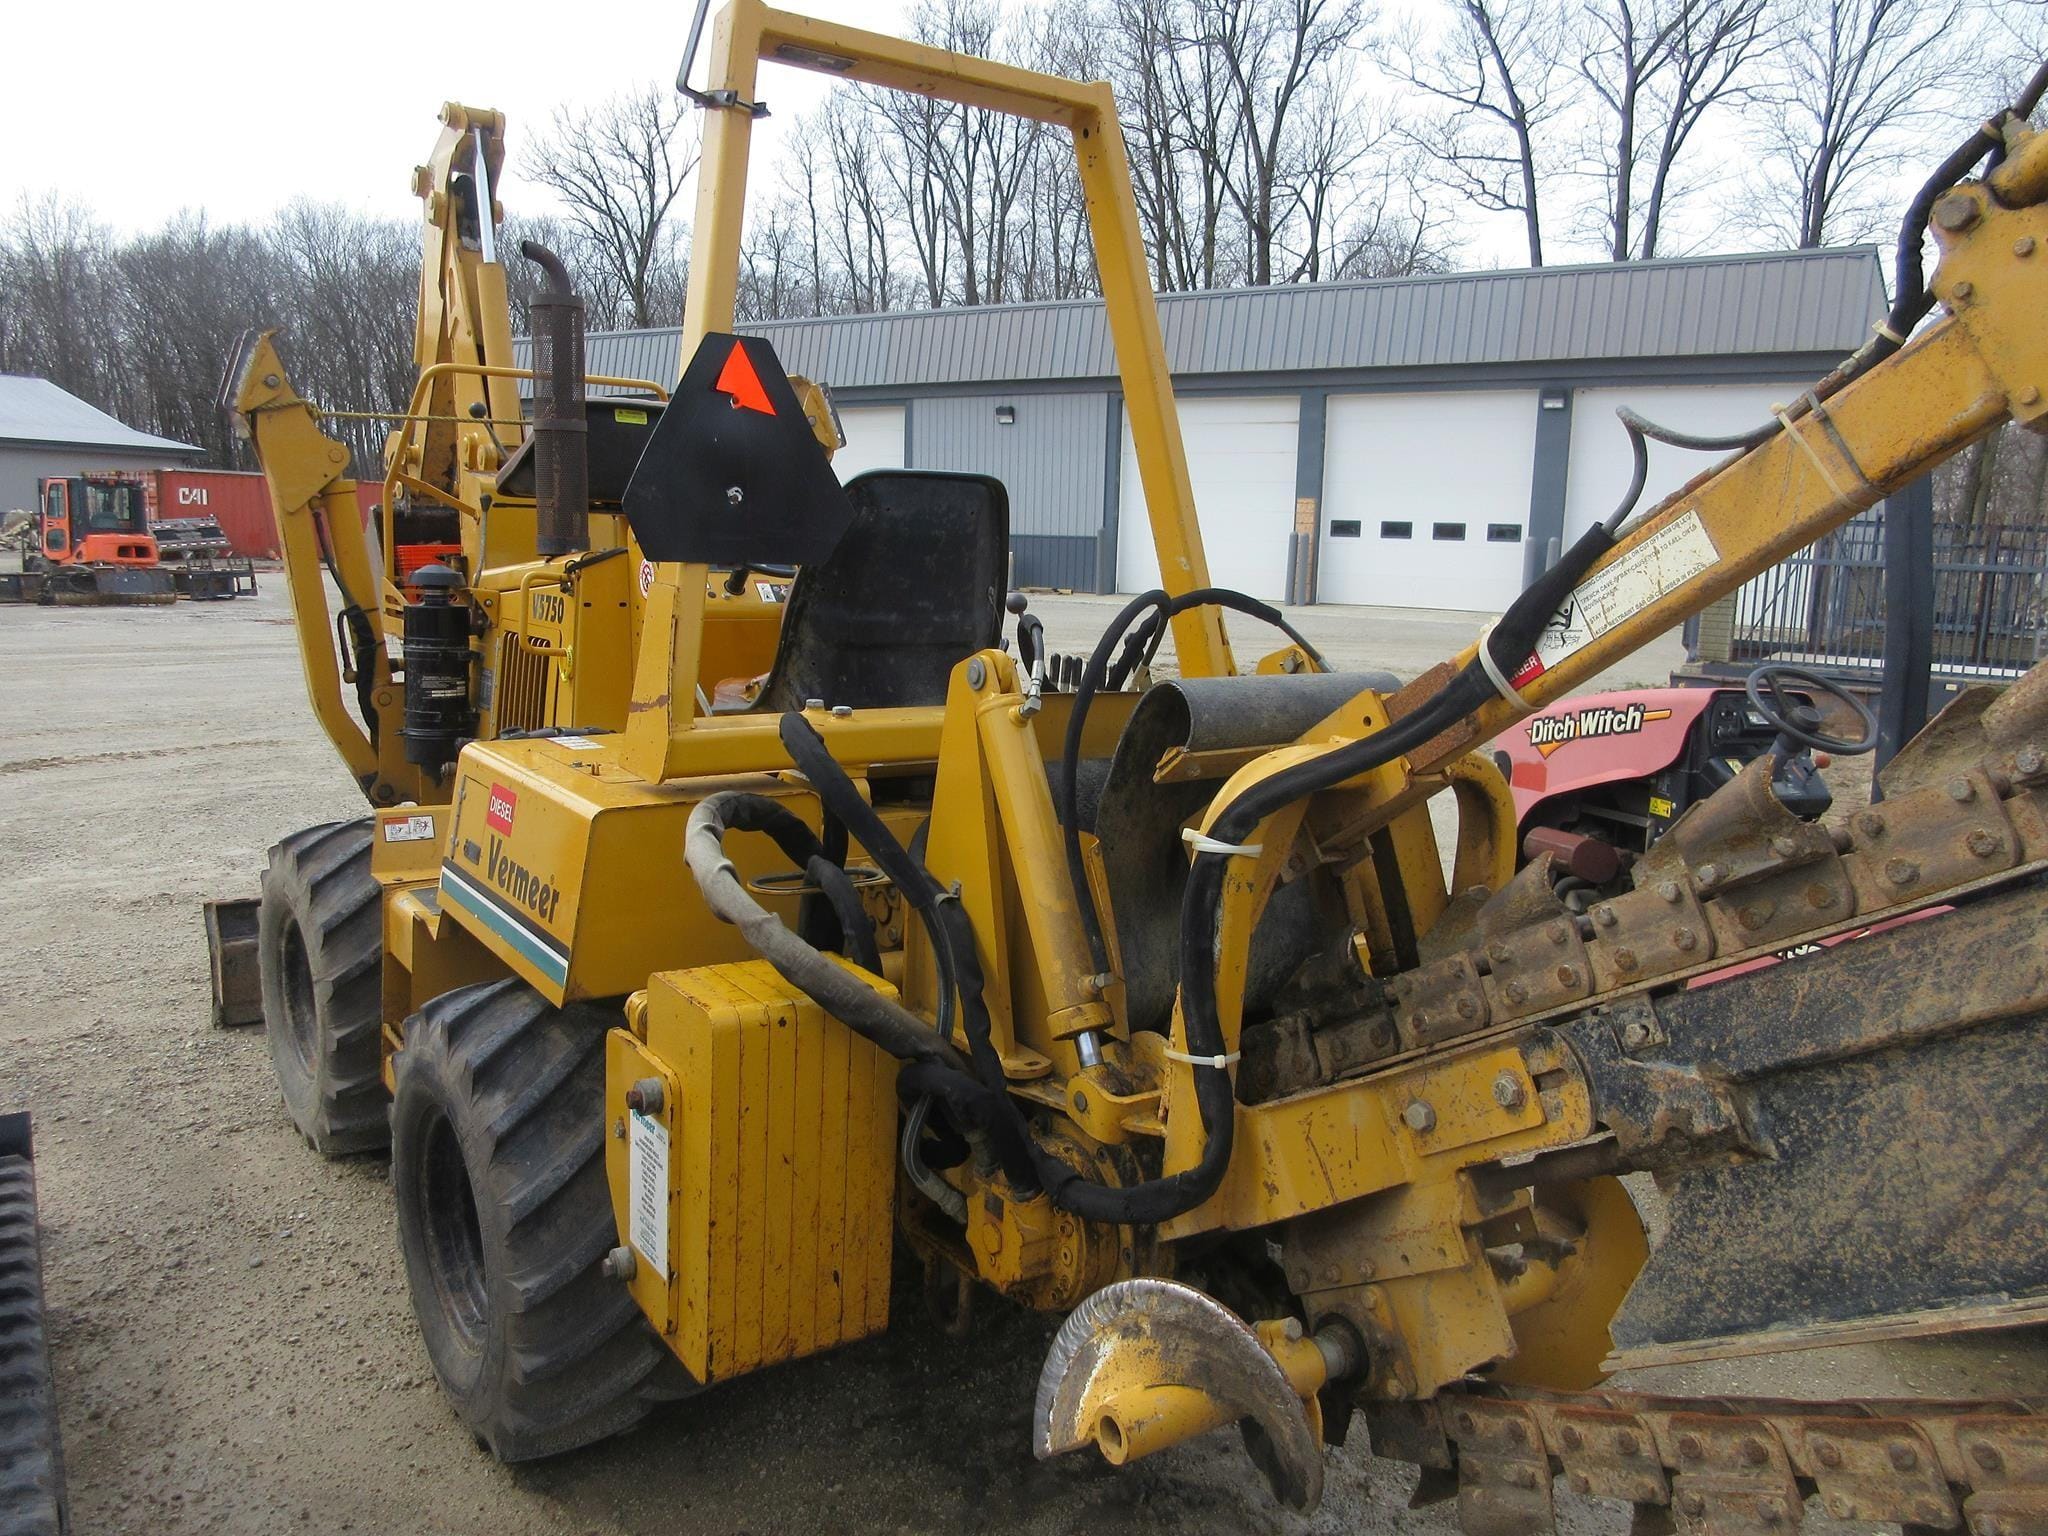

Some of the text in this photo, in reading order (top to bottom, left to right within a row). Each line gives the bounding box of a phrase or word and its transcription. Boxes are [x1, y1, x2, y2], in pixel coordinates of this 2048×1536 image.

[178, 487, 208, 505] CAI
[1589, 613, 1602, 624] STAY
[1532, 705, 1641, 744] Ditch Witch
[490, 796, 513, 823] DIESEL
[488, 834, 560, 924] Vermeer
